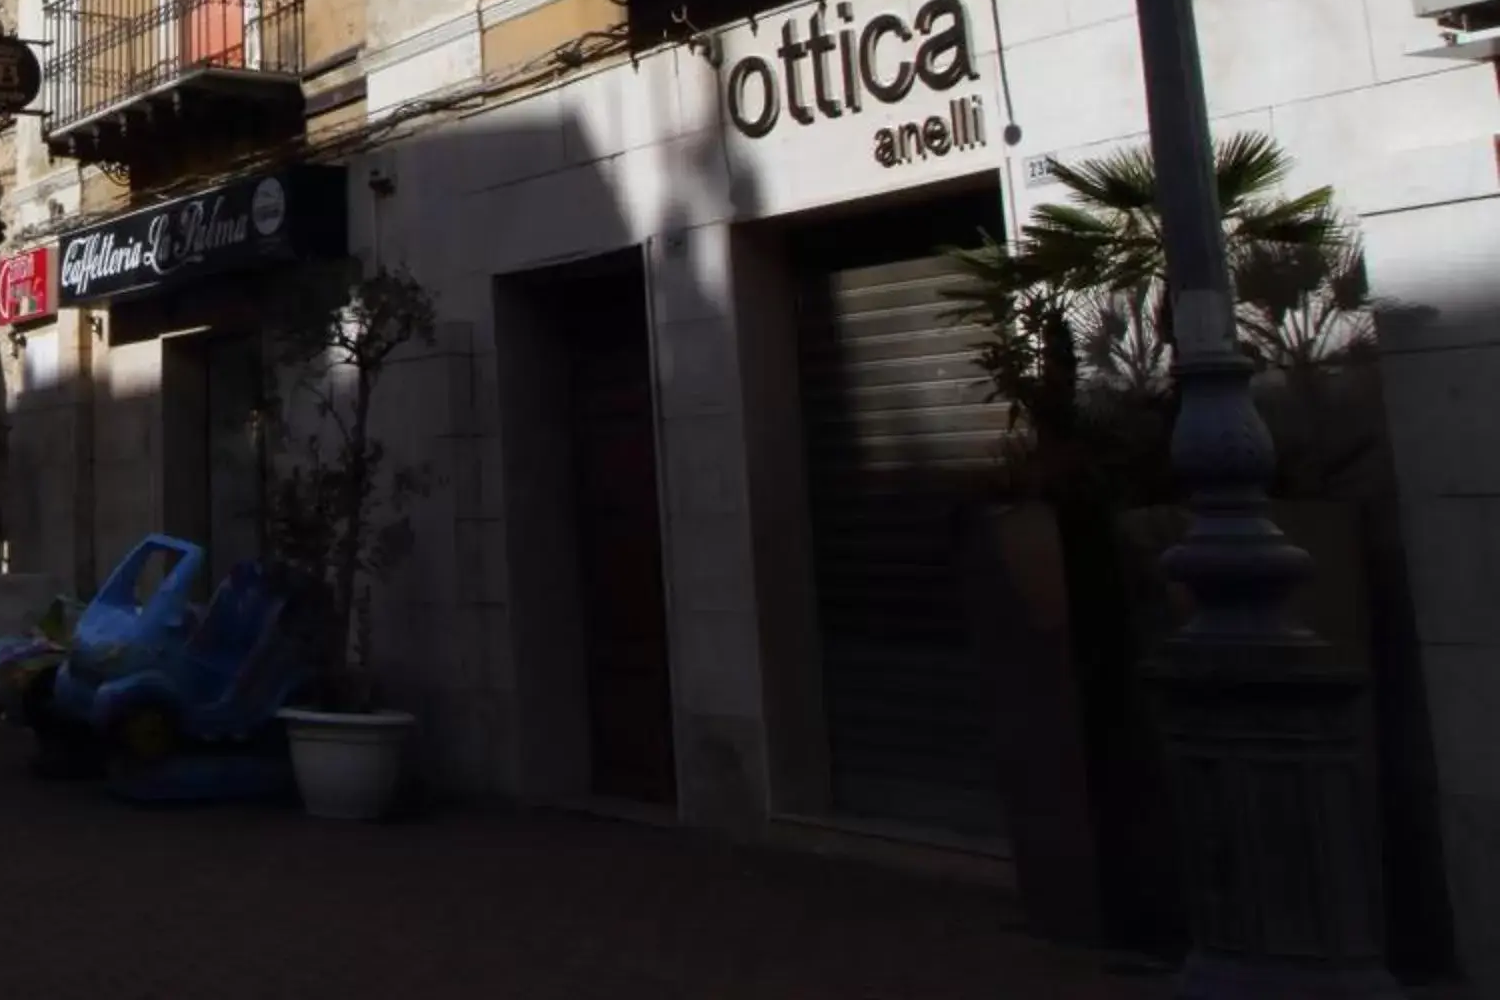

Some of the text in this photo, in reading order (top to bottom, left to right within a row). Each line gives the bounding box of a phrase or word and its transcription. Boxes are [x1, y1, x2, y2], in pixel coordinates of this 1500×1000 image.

[874, 95, 987, 168] anelli
[61, 231, 143, 296] Caffetteria
[142, 213, 186, 276] La
[174, 195, 248, 259] Palma
